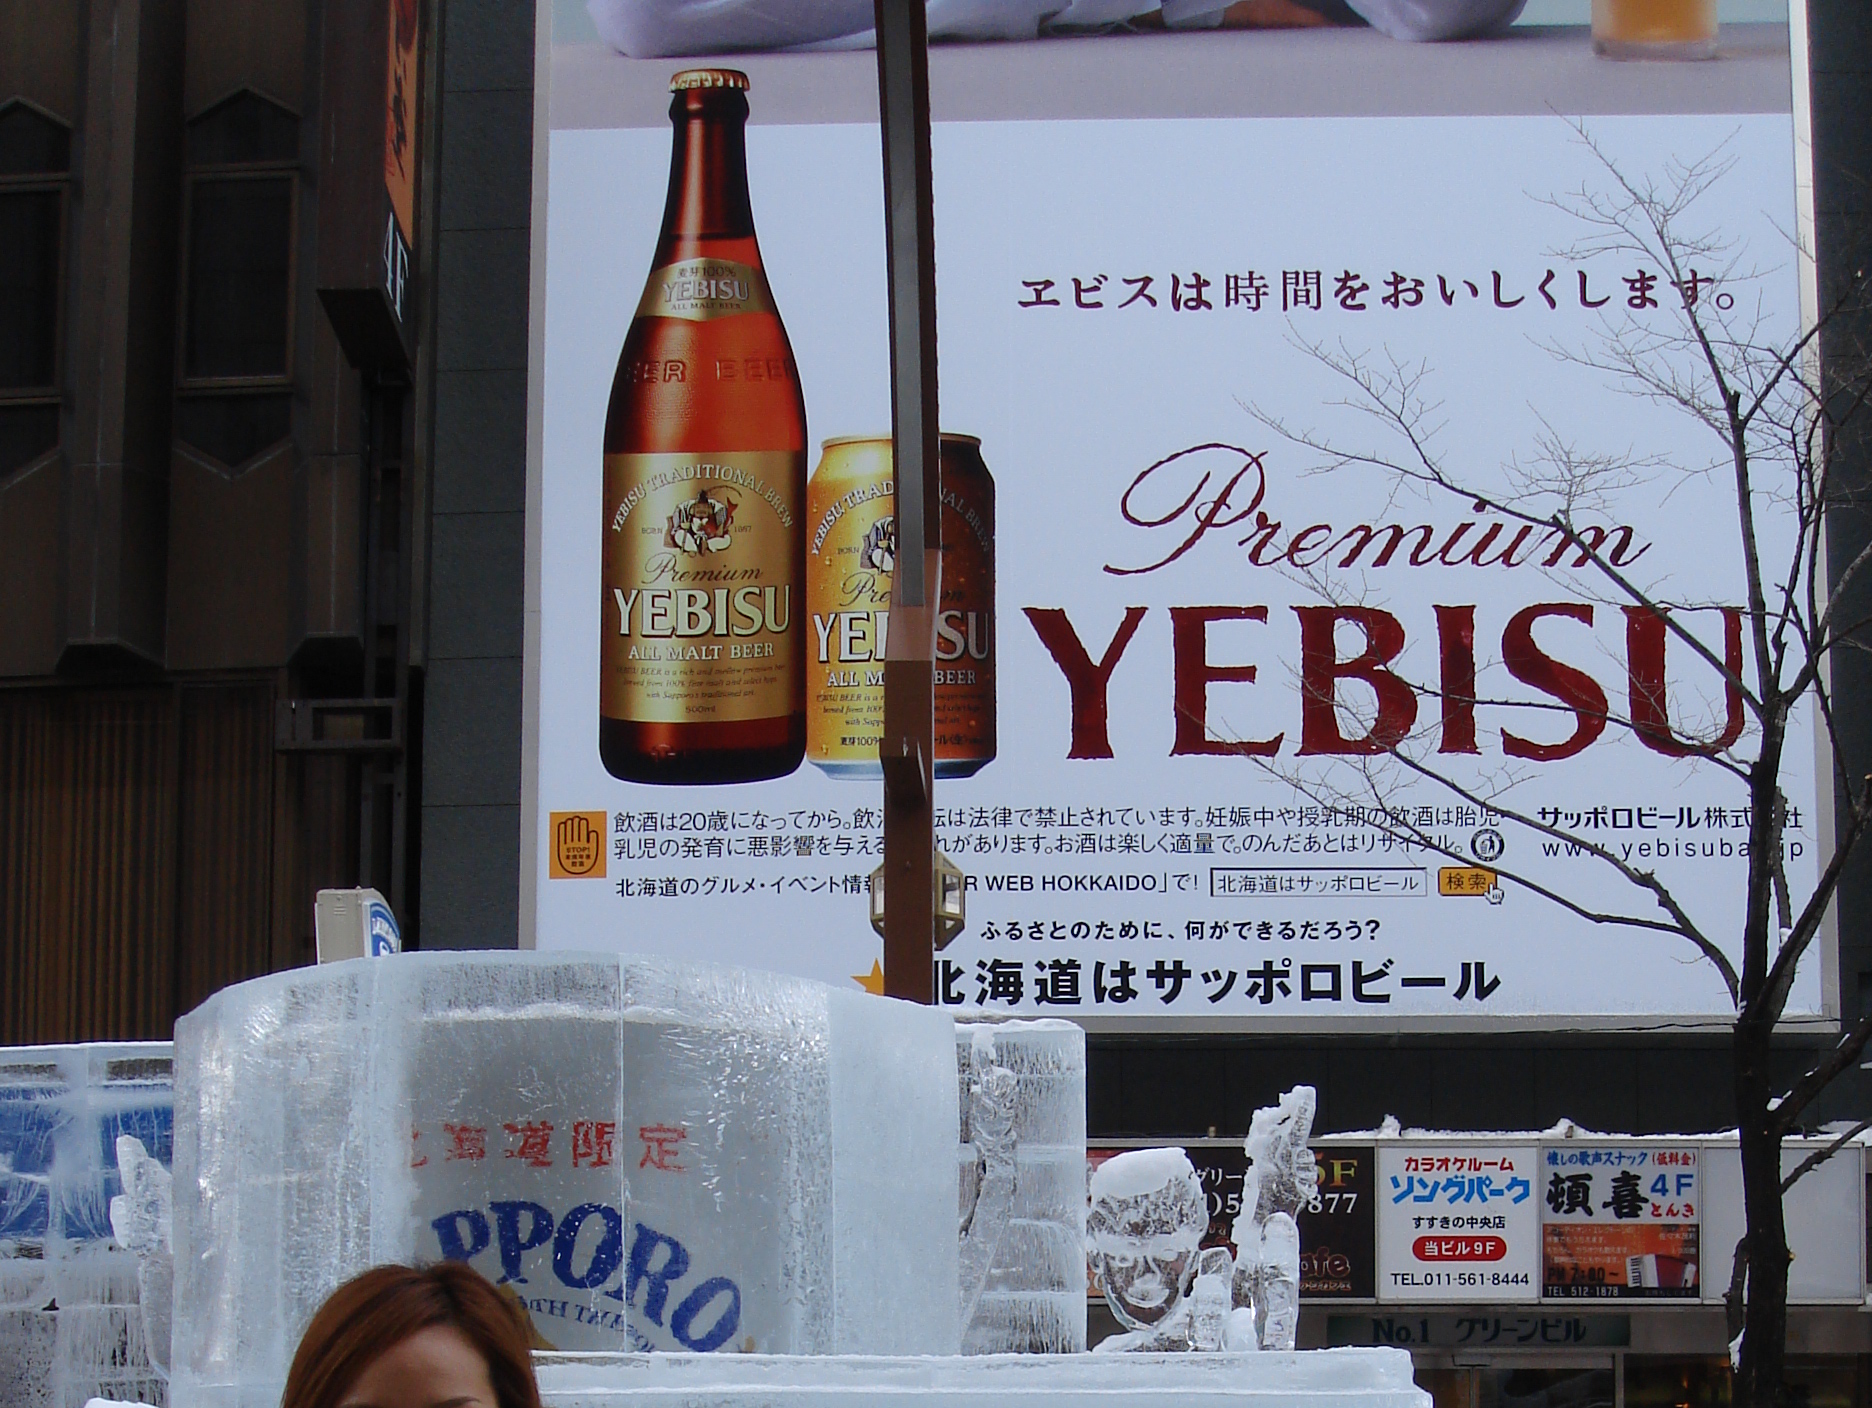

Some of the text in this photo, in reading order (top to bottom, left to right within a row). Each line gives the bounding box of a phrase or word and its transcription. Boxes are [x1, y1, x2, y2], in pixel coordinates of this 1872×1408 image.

[662, 279, 748, 302] YEBISU
[1018, 267, 1735, 313] ヱビスは時間をおいしくします。
[612, 464, 793, 533] YEBISU TRADITIONAL BREW
[1104, 442, 1652, 576] Premium
[812, 502, 846, 556] YEBISU
[641, 552, 763, 584] Premium
[613, 585, 791, 637] YEBISU
[813, 610, 989, 663] YESU
[628, 643, 774, 661] ALL MALT BEER
[828, 671, 859, 687] ALL
[934, 670, 976, 685] BEER
[1023, 602, 1746, 762] YEBISU
[1537, 805, 1804, 829] サッポロビール株式社
[985, 874, 1034, 892] WEB
[1217, 873, 1420, 894] 北海道はサッポロビール
[1446, 872, 1487, 891] 検索
[980, 919, 1380, 941] ふるさとのために、何ができるだろう?
[1405, 1157, 1515, 1172] カラオケルーム
[1390, 1174, 1530, 1205] ソングパーク
[1650, 1174, 1694, 1197] 4F
[1650, 1202, 1695, 1218] とんき
[1413, 1216, 1506, 1229] すすきの中央店
[1390, 1273, 1530, 1286] TEL.011-561-8444
[1547, 1286, 1619, 1297] TEL 512-1878
[1372, 1317, 1587, 1344] No.1 グリーンビル
